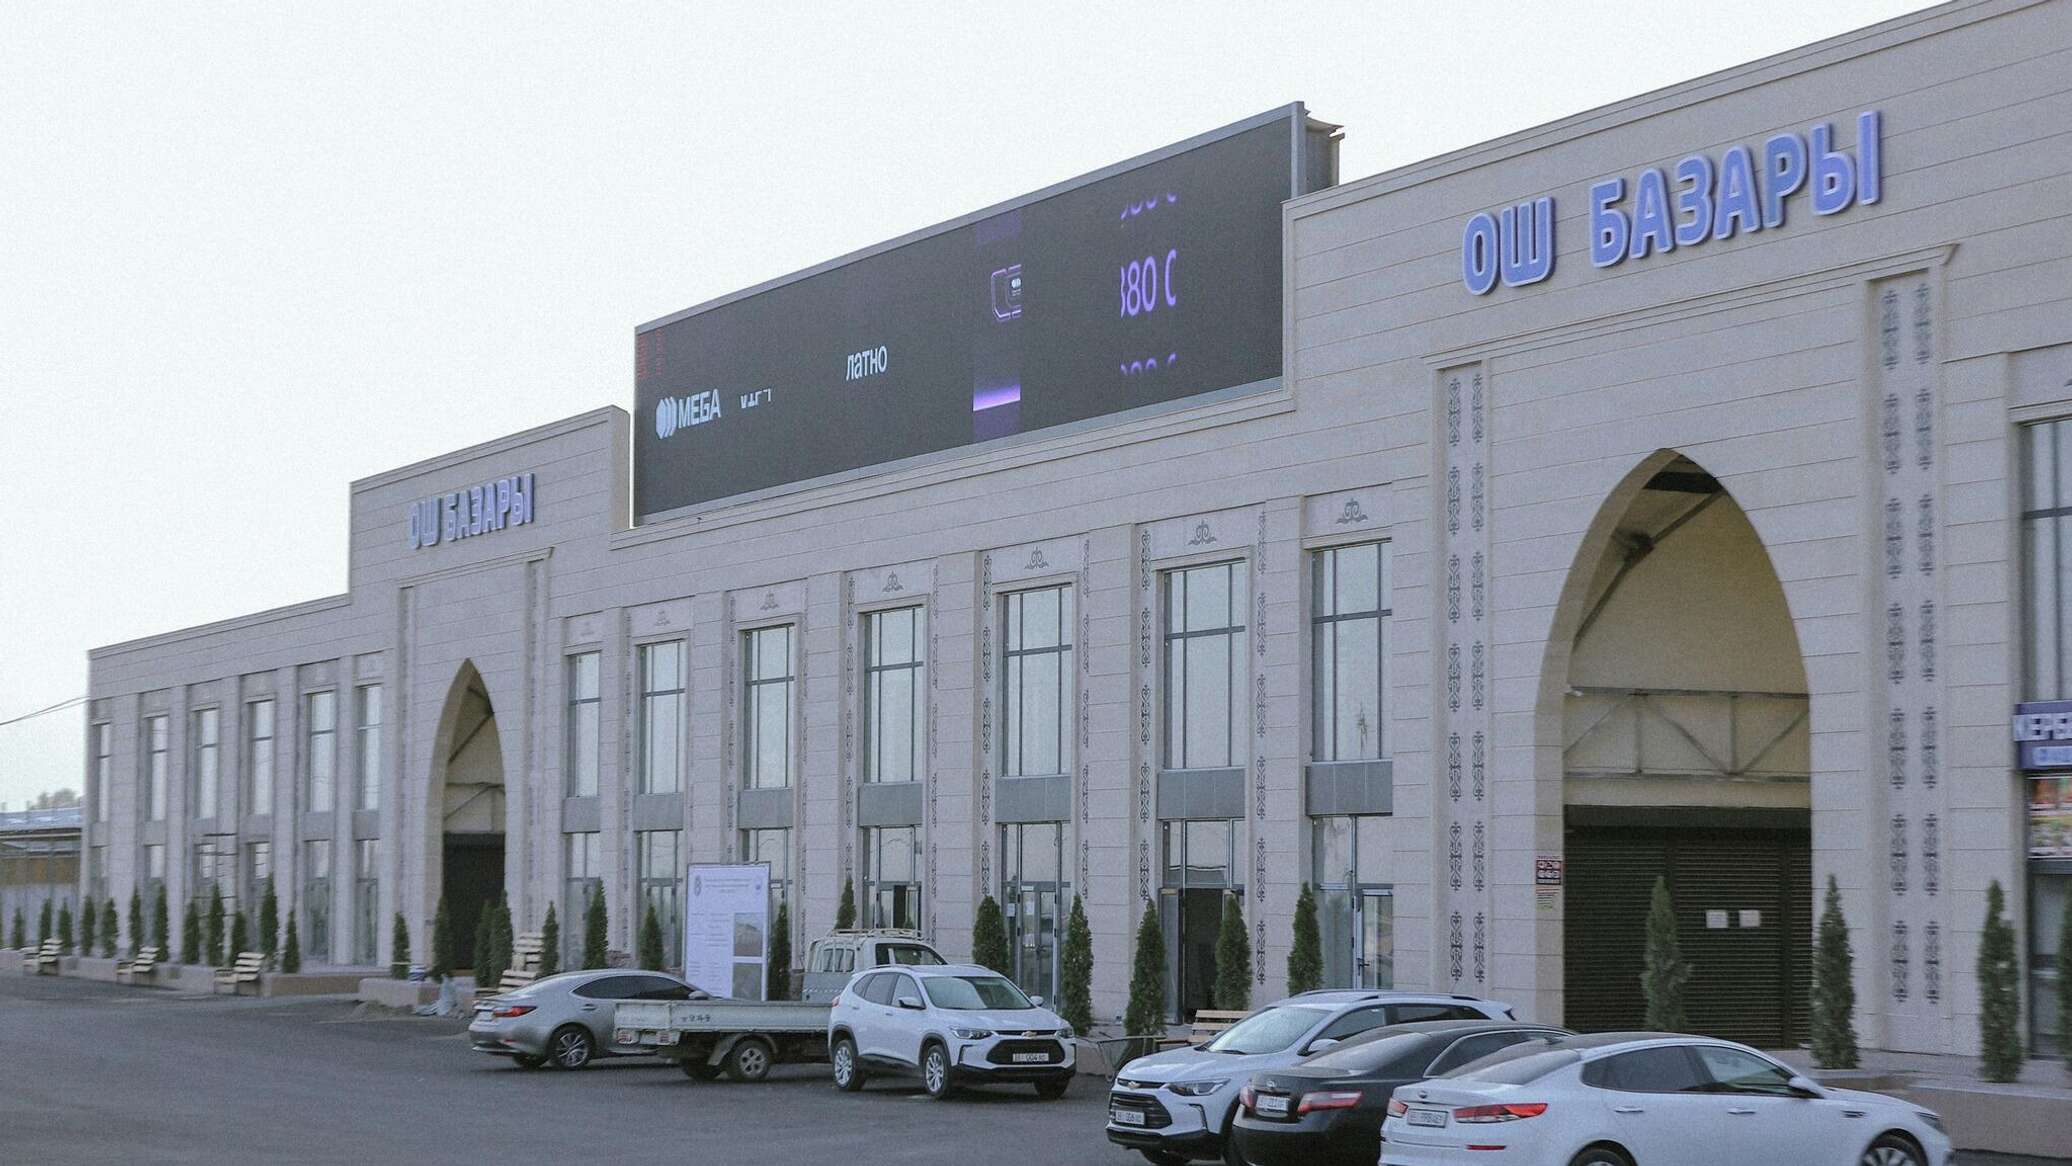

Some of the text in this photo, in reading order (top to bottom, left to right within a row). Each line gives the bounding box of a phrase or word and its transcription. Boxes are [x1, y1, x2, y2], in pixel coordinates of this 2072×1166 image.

[1462, 111, 1884, 296] ОШ БАЗАРЫ
[846, 345, 888, 380] латно
[678, 388, 721, 429] MEGA
[410, 474, 535, 549] ОШ БАЗАРЫ
